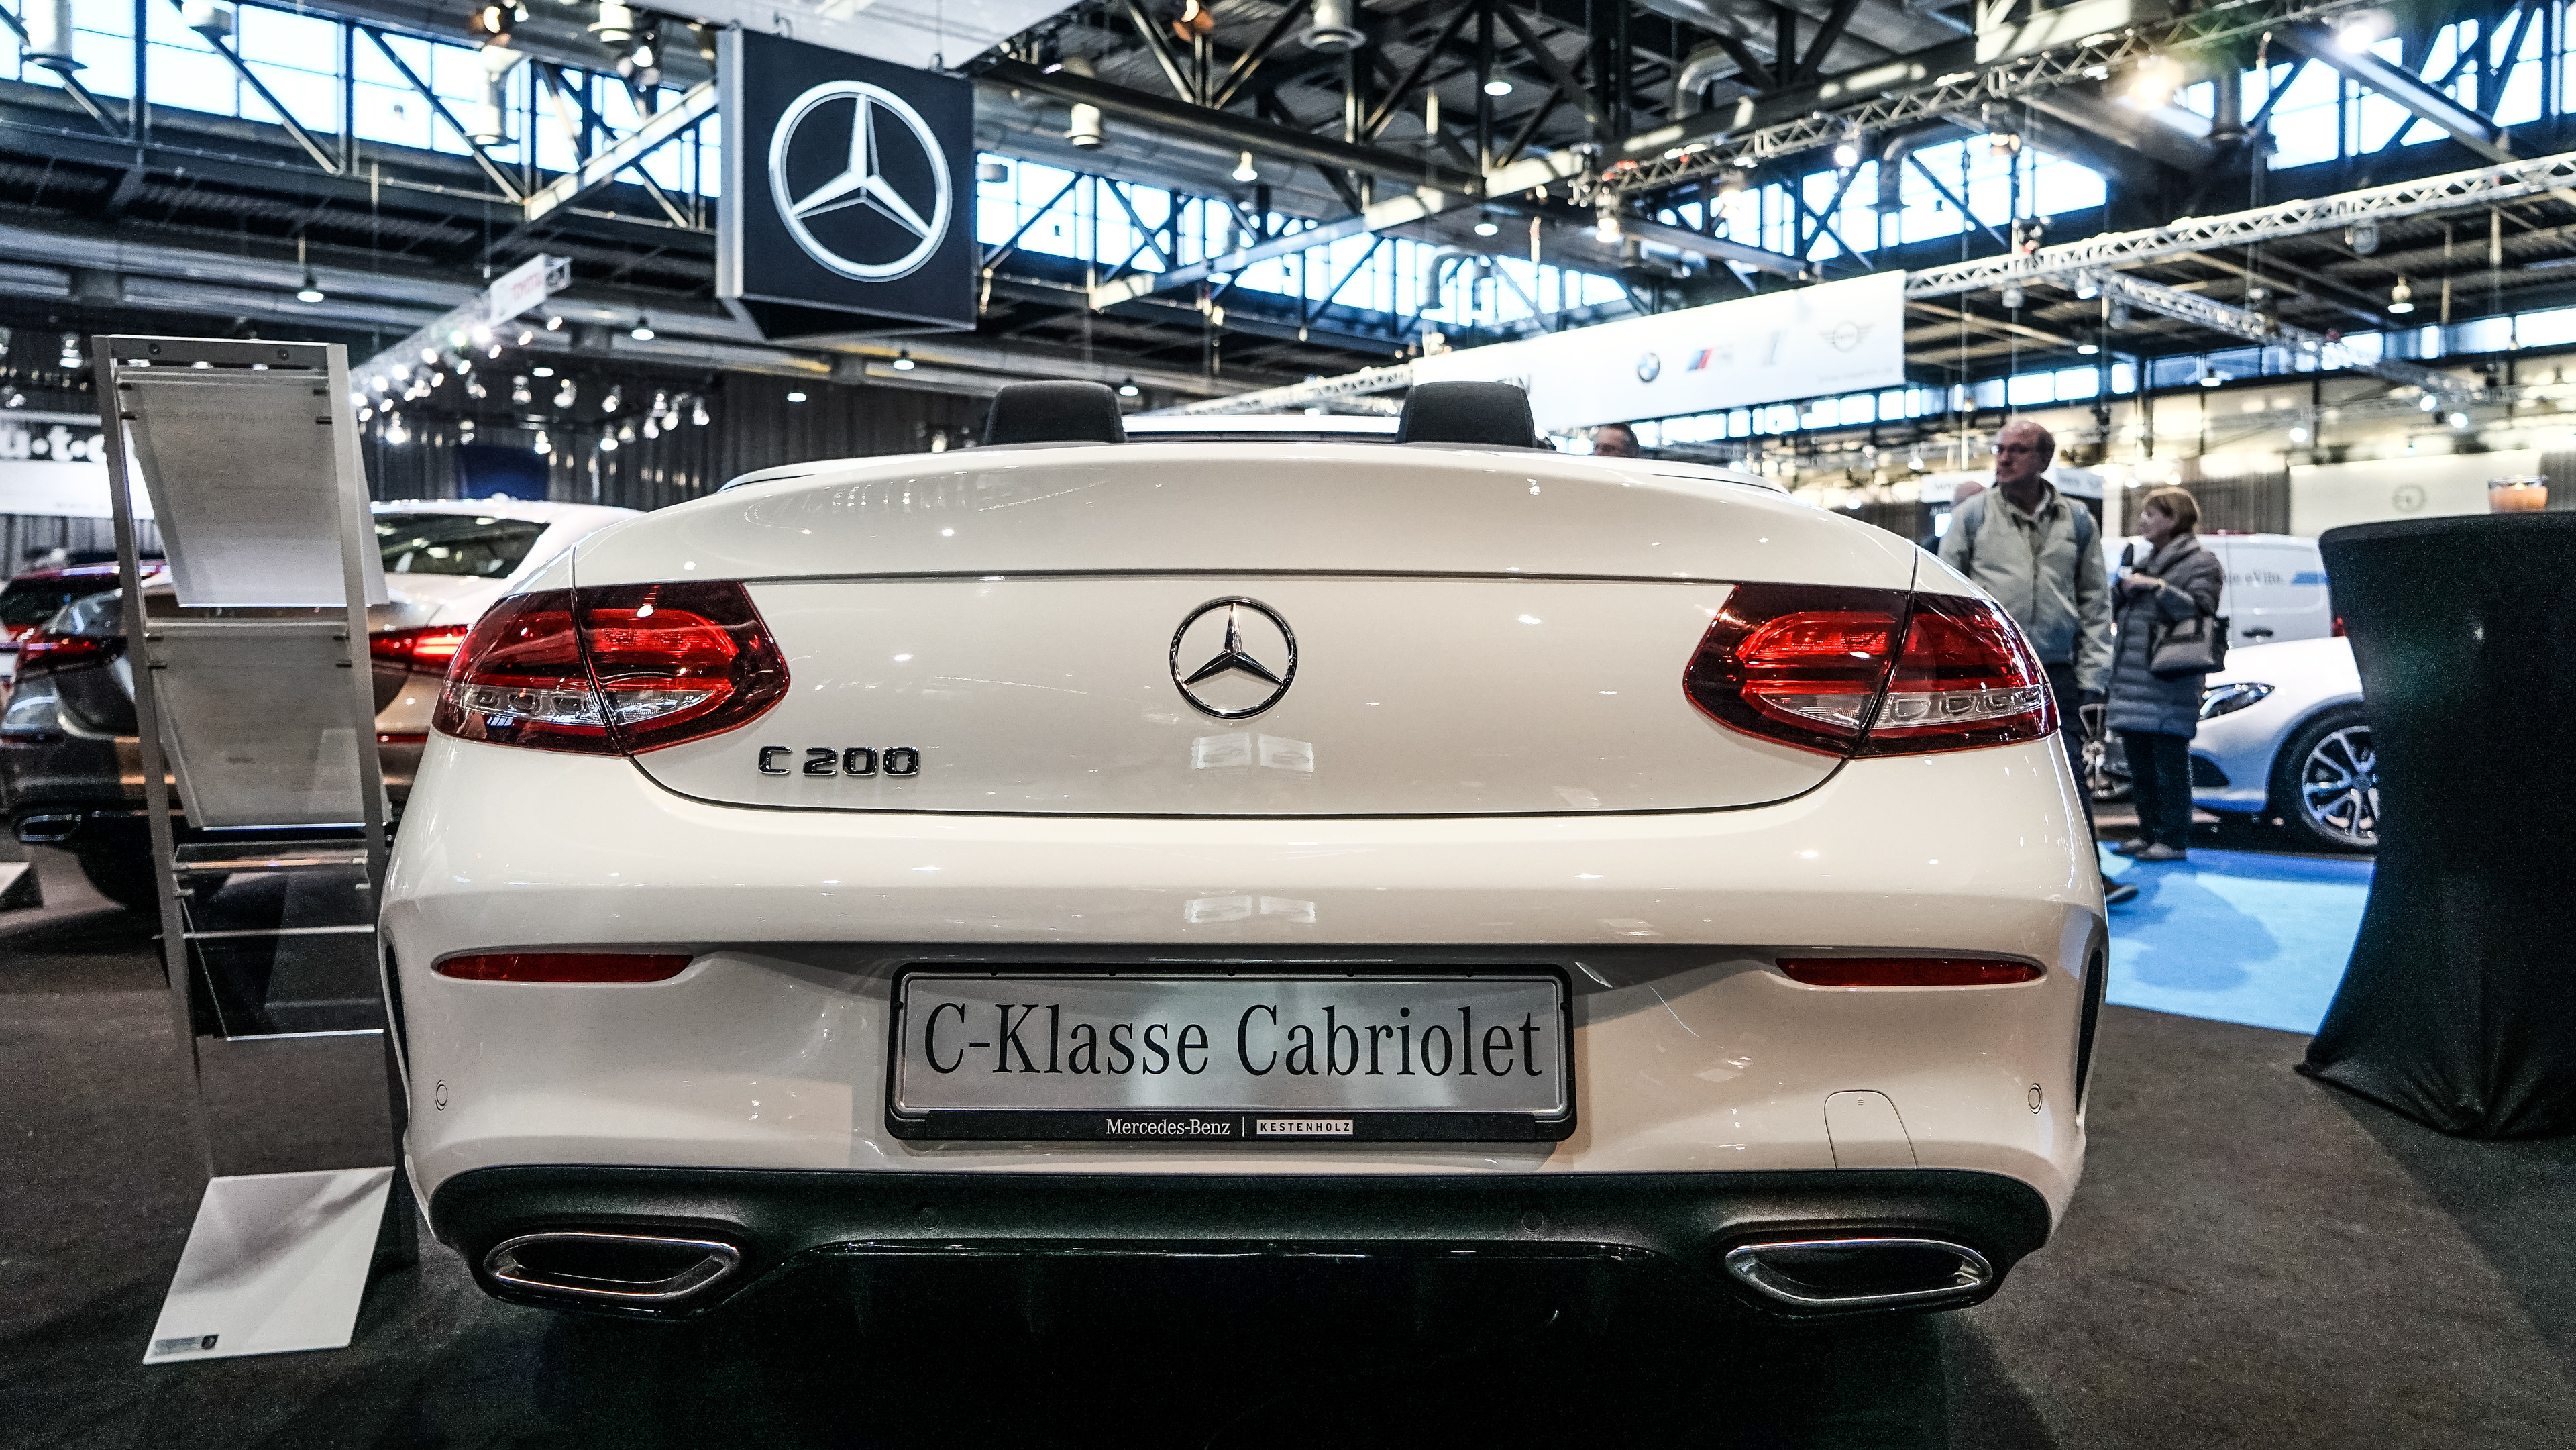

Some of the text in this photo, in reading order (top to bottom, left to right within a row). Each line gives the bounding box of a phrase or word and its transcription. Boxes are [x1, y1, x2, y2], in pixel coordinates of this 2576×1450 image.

[759, 745, 920, 776] C 200
[925, 1002, 1542, 1076] C-Klasse Cabriolet
[1105, 1118, 1350, 1135] Mercedes-Benz KESTENHOLZ
